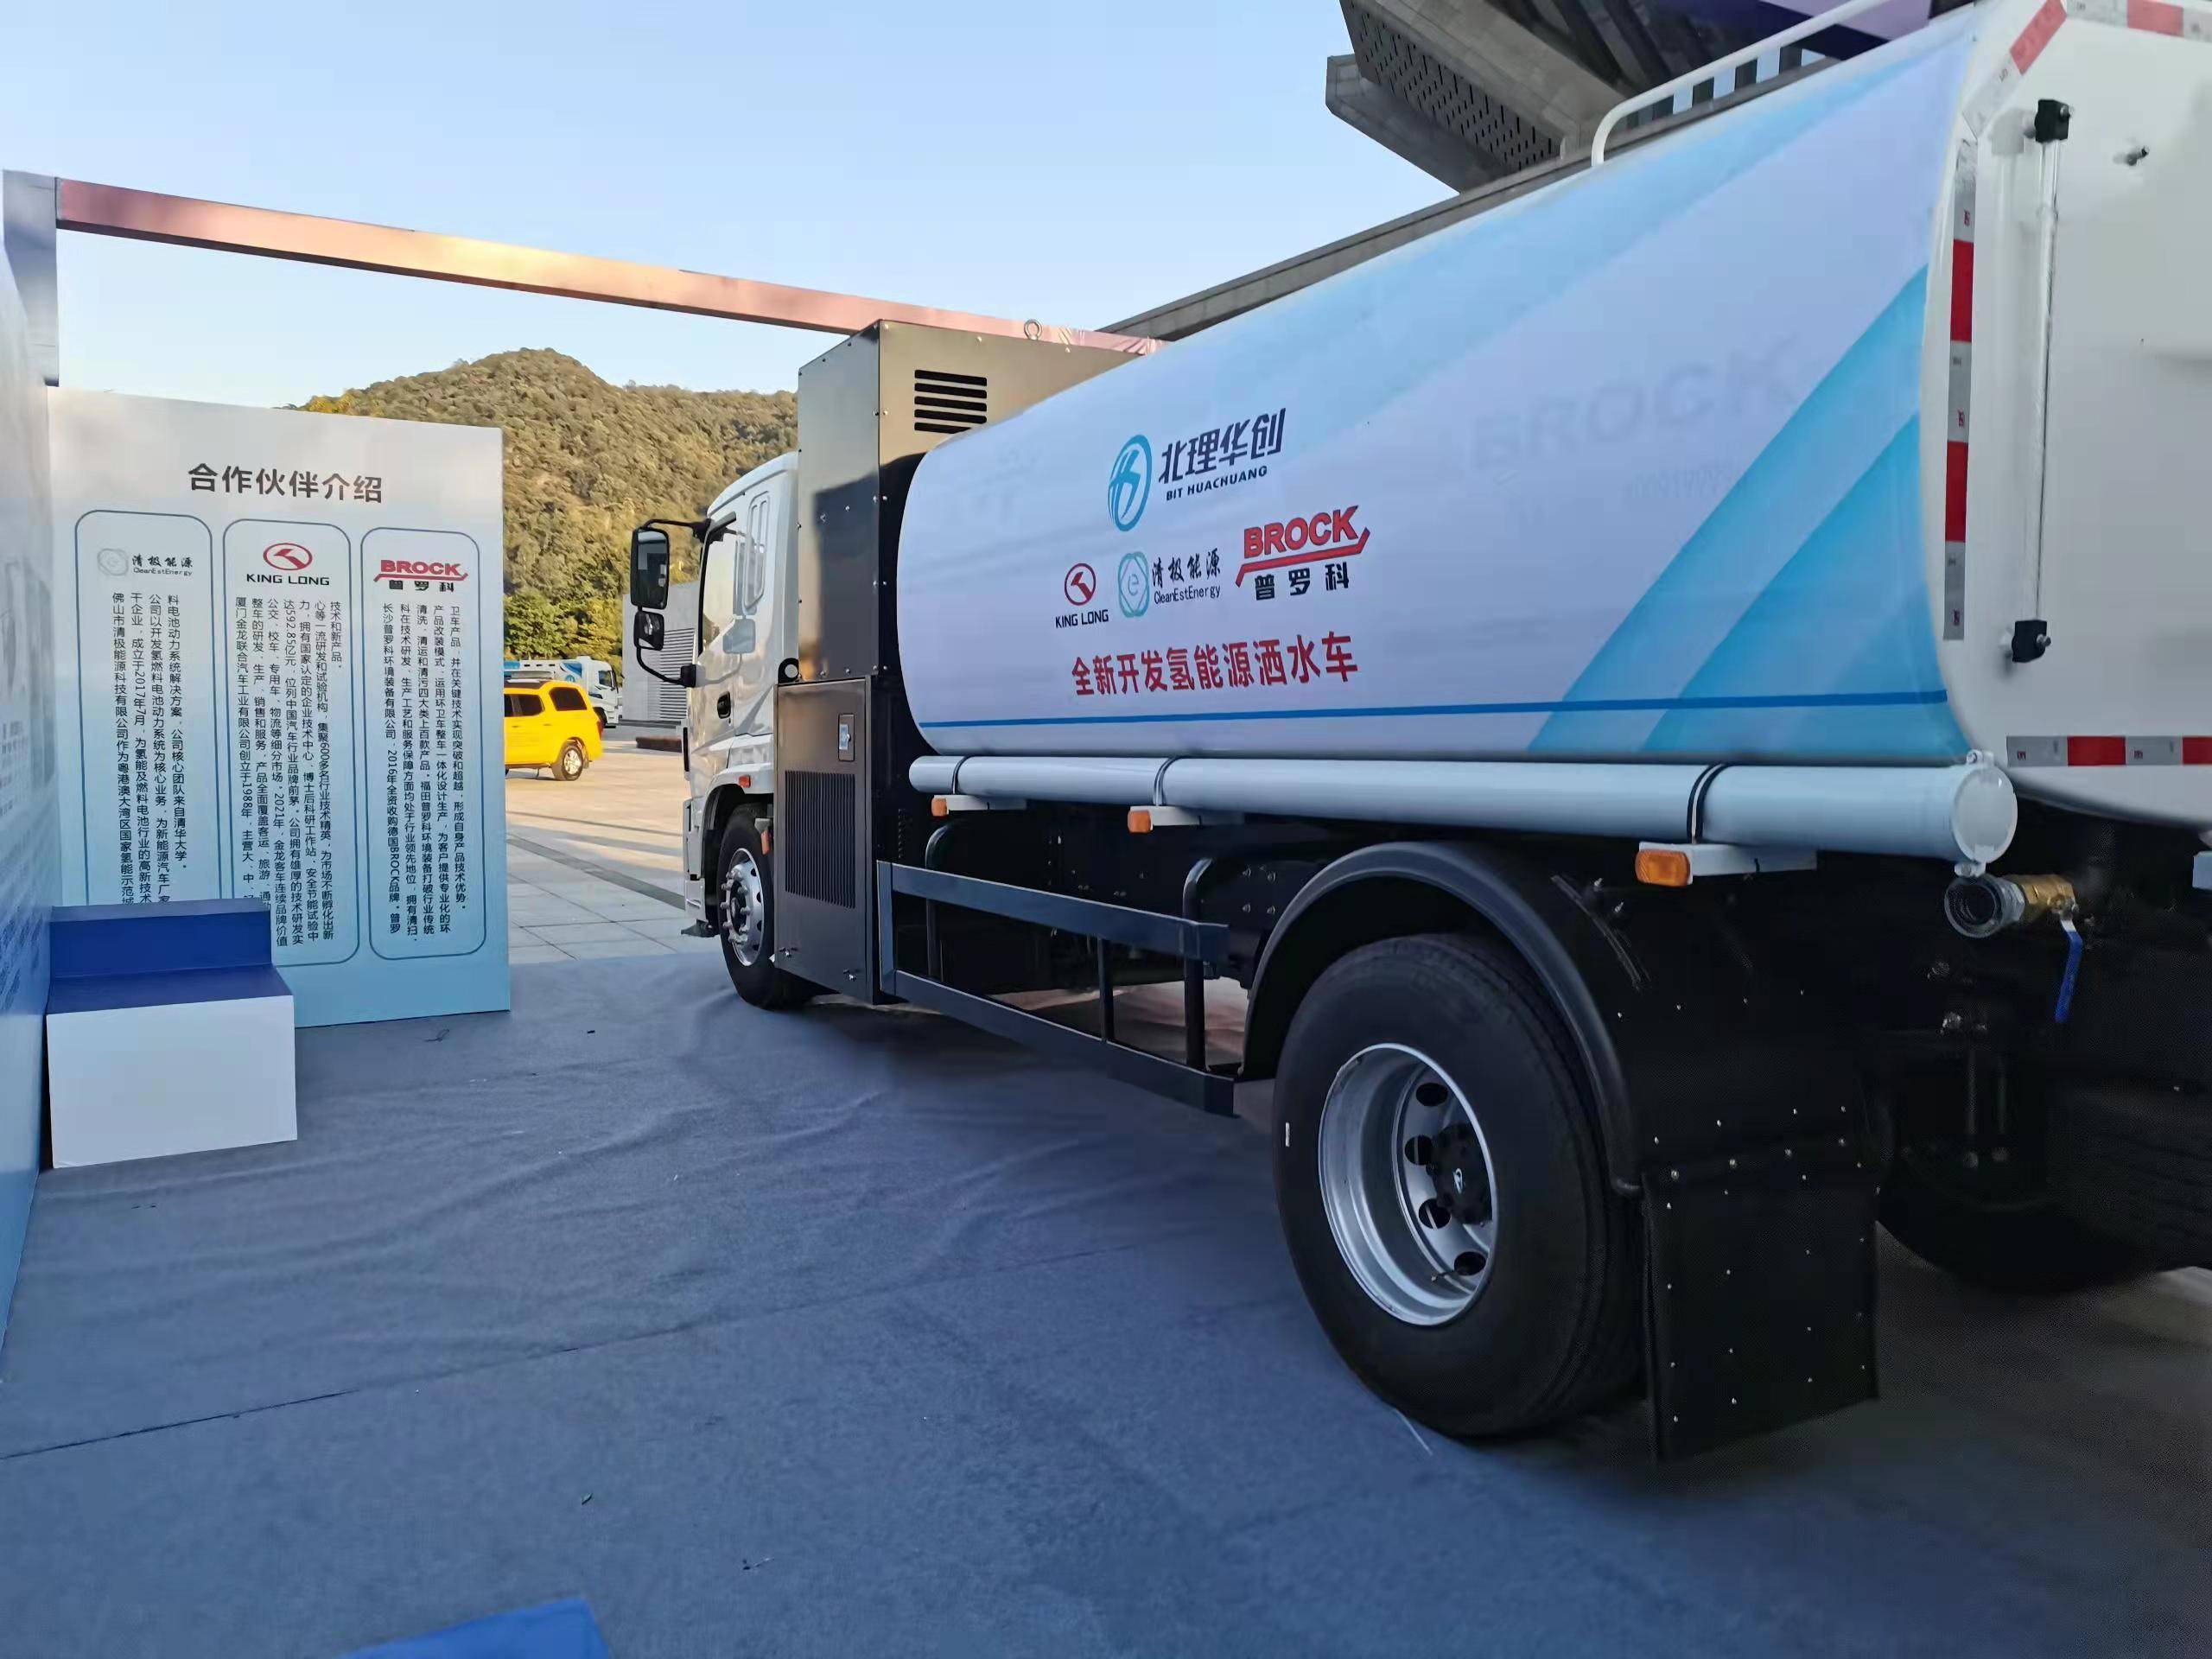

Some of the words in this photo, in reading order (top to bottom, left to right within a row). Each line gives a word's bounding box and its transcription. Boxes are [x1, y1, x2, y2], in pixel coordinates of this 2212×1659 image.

[1158, 407, 1287, 484] 北理华创
[188, 462, 383, 503] 合作伙伴介绍
[1166, 487, 1185, 501] BIT
[1187, 465, 1268, 498] HUACHUANG
[1243, 505, 1359, 559] BROCK
[131, 552, 194, 568] 清极能源
[380, 559, 461, 576] BROCK
[1152, 547, 1222, 588] 清极能源
[246, 573, 283, 584] KING
[288, 575, 330, 586] LONG
[1154, 582, 1222, 605] CleanEstEnergy
[1254, 561, 1351, 601] 普罗科
[1055, 613, 1078, 629] KING
[1081, 608, 1109, 625] LONG
[1071, 629, 1358, 696] 全新开发氢能源洒水车
